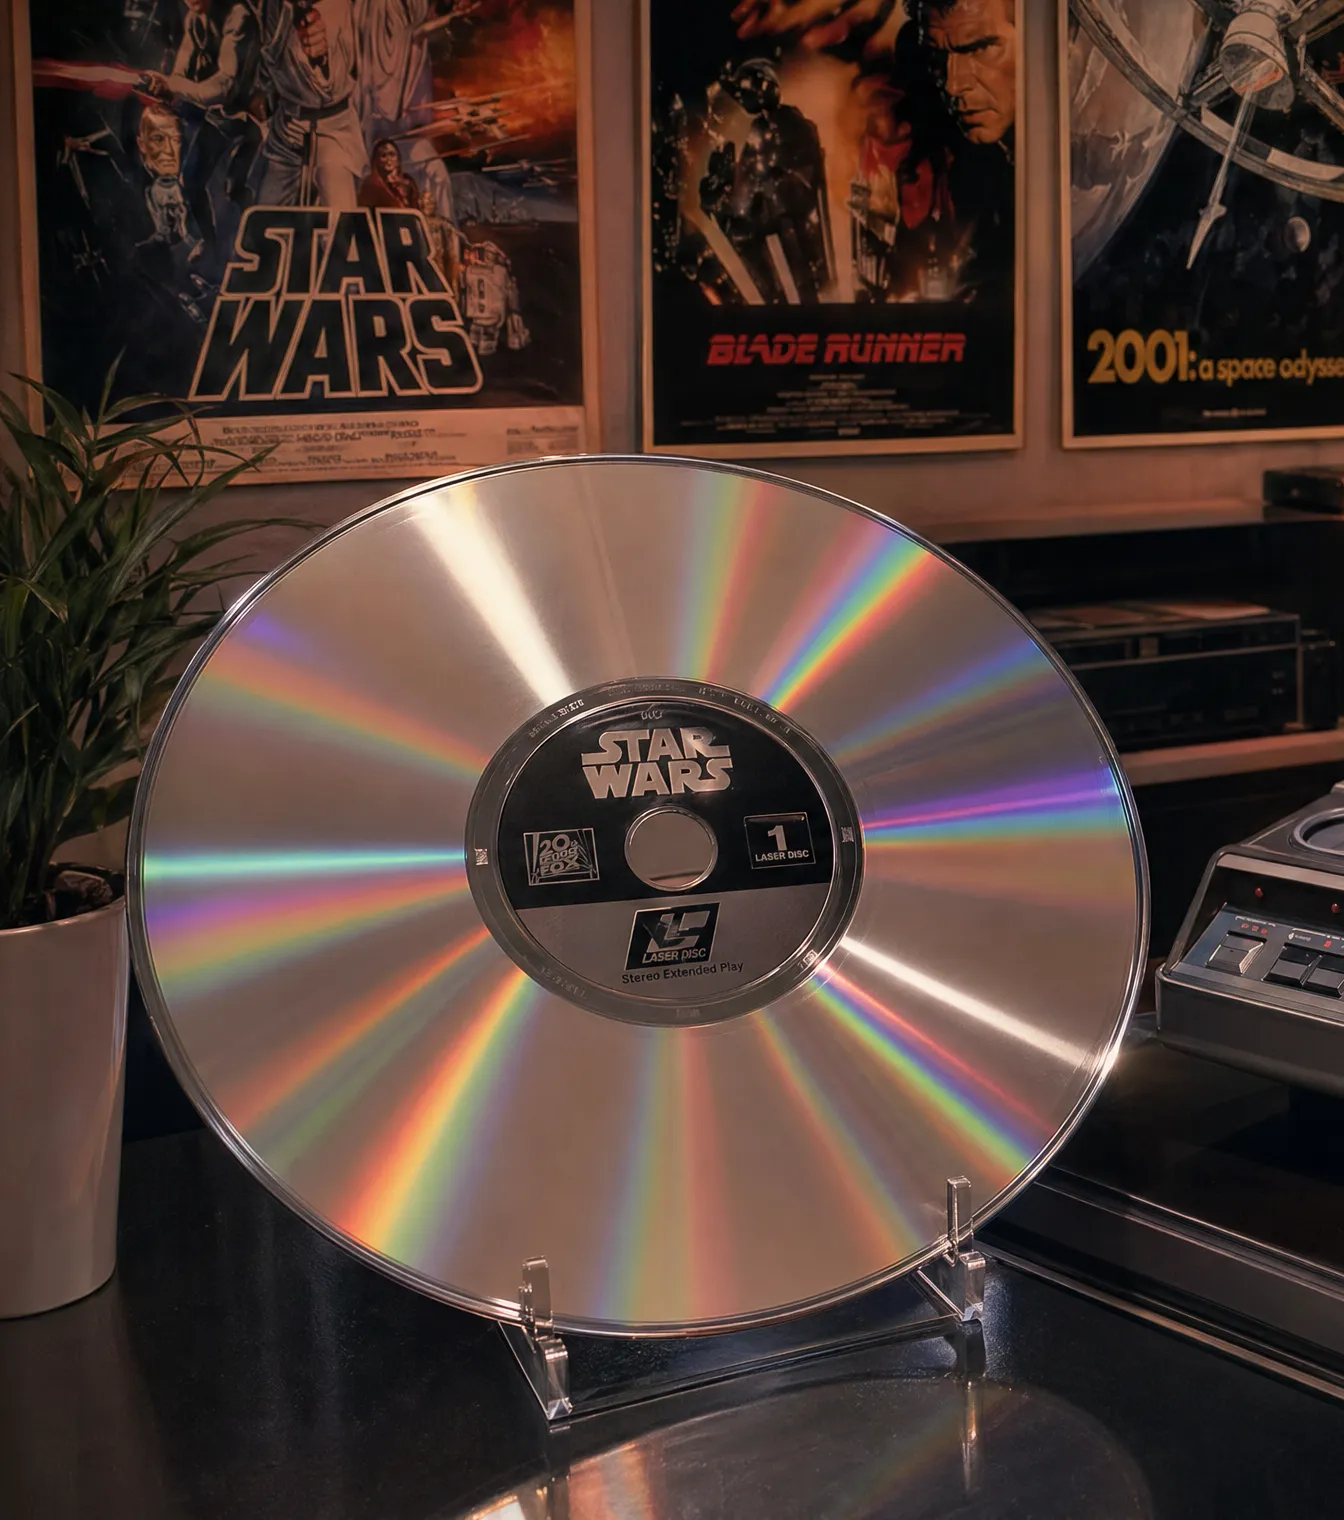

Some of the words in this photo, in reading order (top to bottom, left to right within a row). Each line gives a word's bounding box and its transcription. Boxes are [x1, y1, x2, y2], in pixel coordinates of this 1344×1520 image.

[219, 205, 455, 299] STAR
[187, 295, 484, 401] WARS
[706, 334, 818, 366] BLADE
[824, 333, 967, 364] RUNNER
[1087, 329, 1198, 384] 2001:
[1199, 358, 1214, 381] a
[1216, 357, 1276, 388] space
[580, 726, 731, 766] STAR
[581, 757, 734, 800] WARS
[754, 850, 786, 863] LASER
[787, 849, 810, 860] DISC
[767, 824, 788, 852] 1
[621, 971, 661, 985] Stereo
[663, 964, 717, 980] Extended
[720, 961, 745, 974] Play
[641, 949, 680, 964] LASER
[681, 947, 707, 961] DISC
